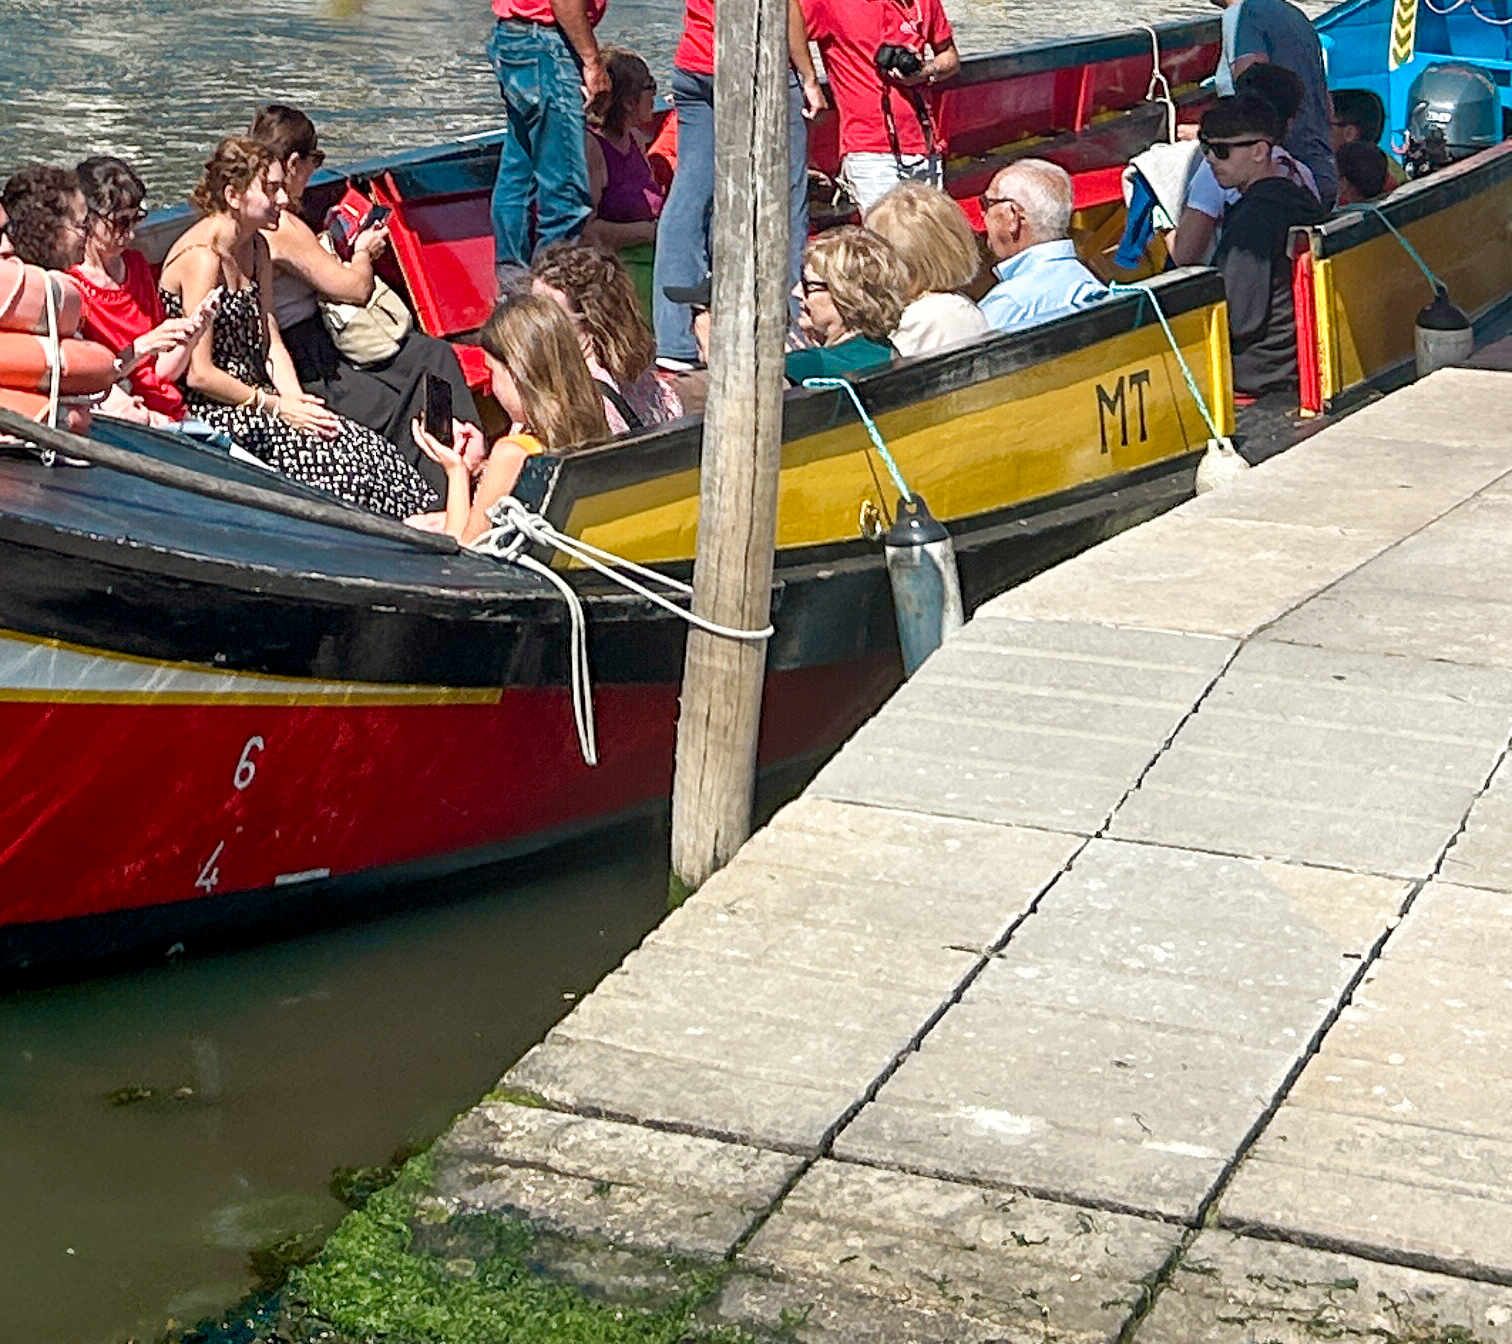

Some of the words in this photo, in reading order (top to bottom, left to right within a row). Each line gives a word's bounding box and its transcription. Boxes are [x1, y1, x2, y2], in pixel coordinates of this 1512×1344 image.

[1095, 368, 1152, 455] MT
[233, 735, 265, 791] 6
[194, 839, 225, 893] 4
